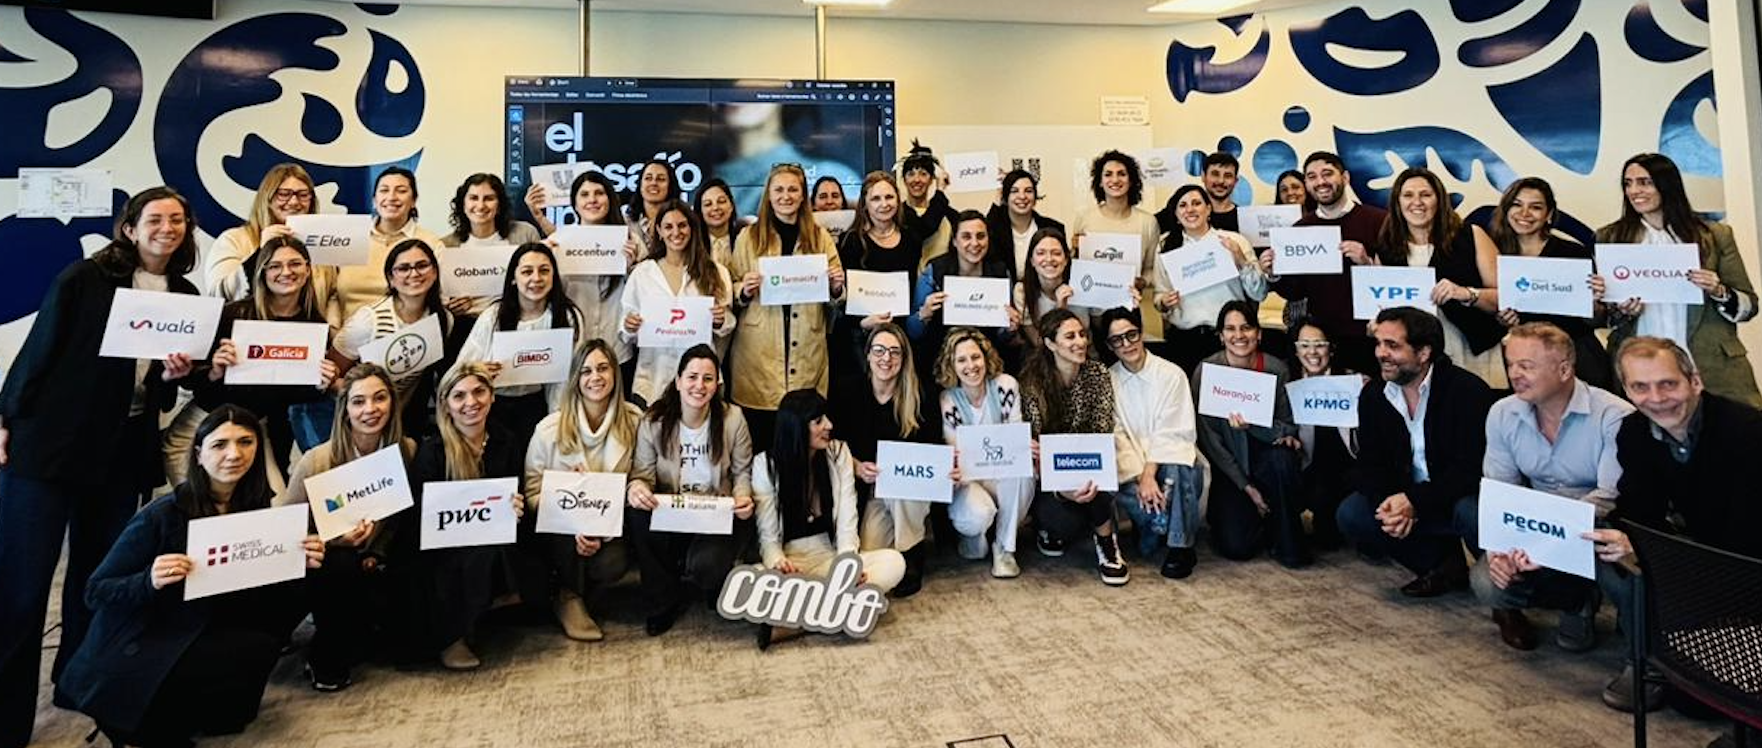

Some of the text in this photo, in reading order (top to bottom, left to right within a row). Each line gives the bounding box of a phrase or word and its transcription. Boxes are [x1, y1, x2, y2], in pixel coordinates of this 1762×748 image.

[545, 111, 583, 152] el
[319, 235, 351, 247] Elea
[565, 246, 616, 257] accenture
[1094, 247, 1124, 261] Cargill
[1284, 244, 1327, 257] BBVA
[454, 266, 499, 278] Globant
[1633, 269, 1684, 279] VEOLIA
[1370, 286, 1420, 300] YPF
[156, 319, 195, 335] ualá
[268, 347, 304, 359] Galicia
[389, 344, 422, 366] BAYER
[518, 353, 550, 363] BIMBO
[1304, 398, 1350, 411] KPMG
[1056, 456, 1100, 468] telecom
[894, 464, 934, 479] MARS
[347, 475, 394, 503] MetLife
[437, 505, 492, 531] pwc
[233, 539, 262, 551] SWISS
[231, 543, 286, 563] MEDICAL
[721, 557, 883, 633] combo
